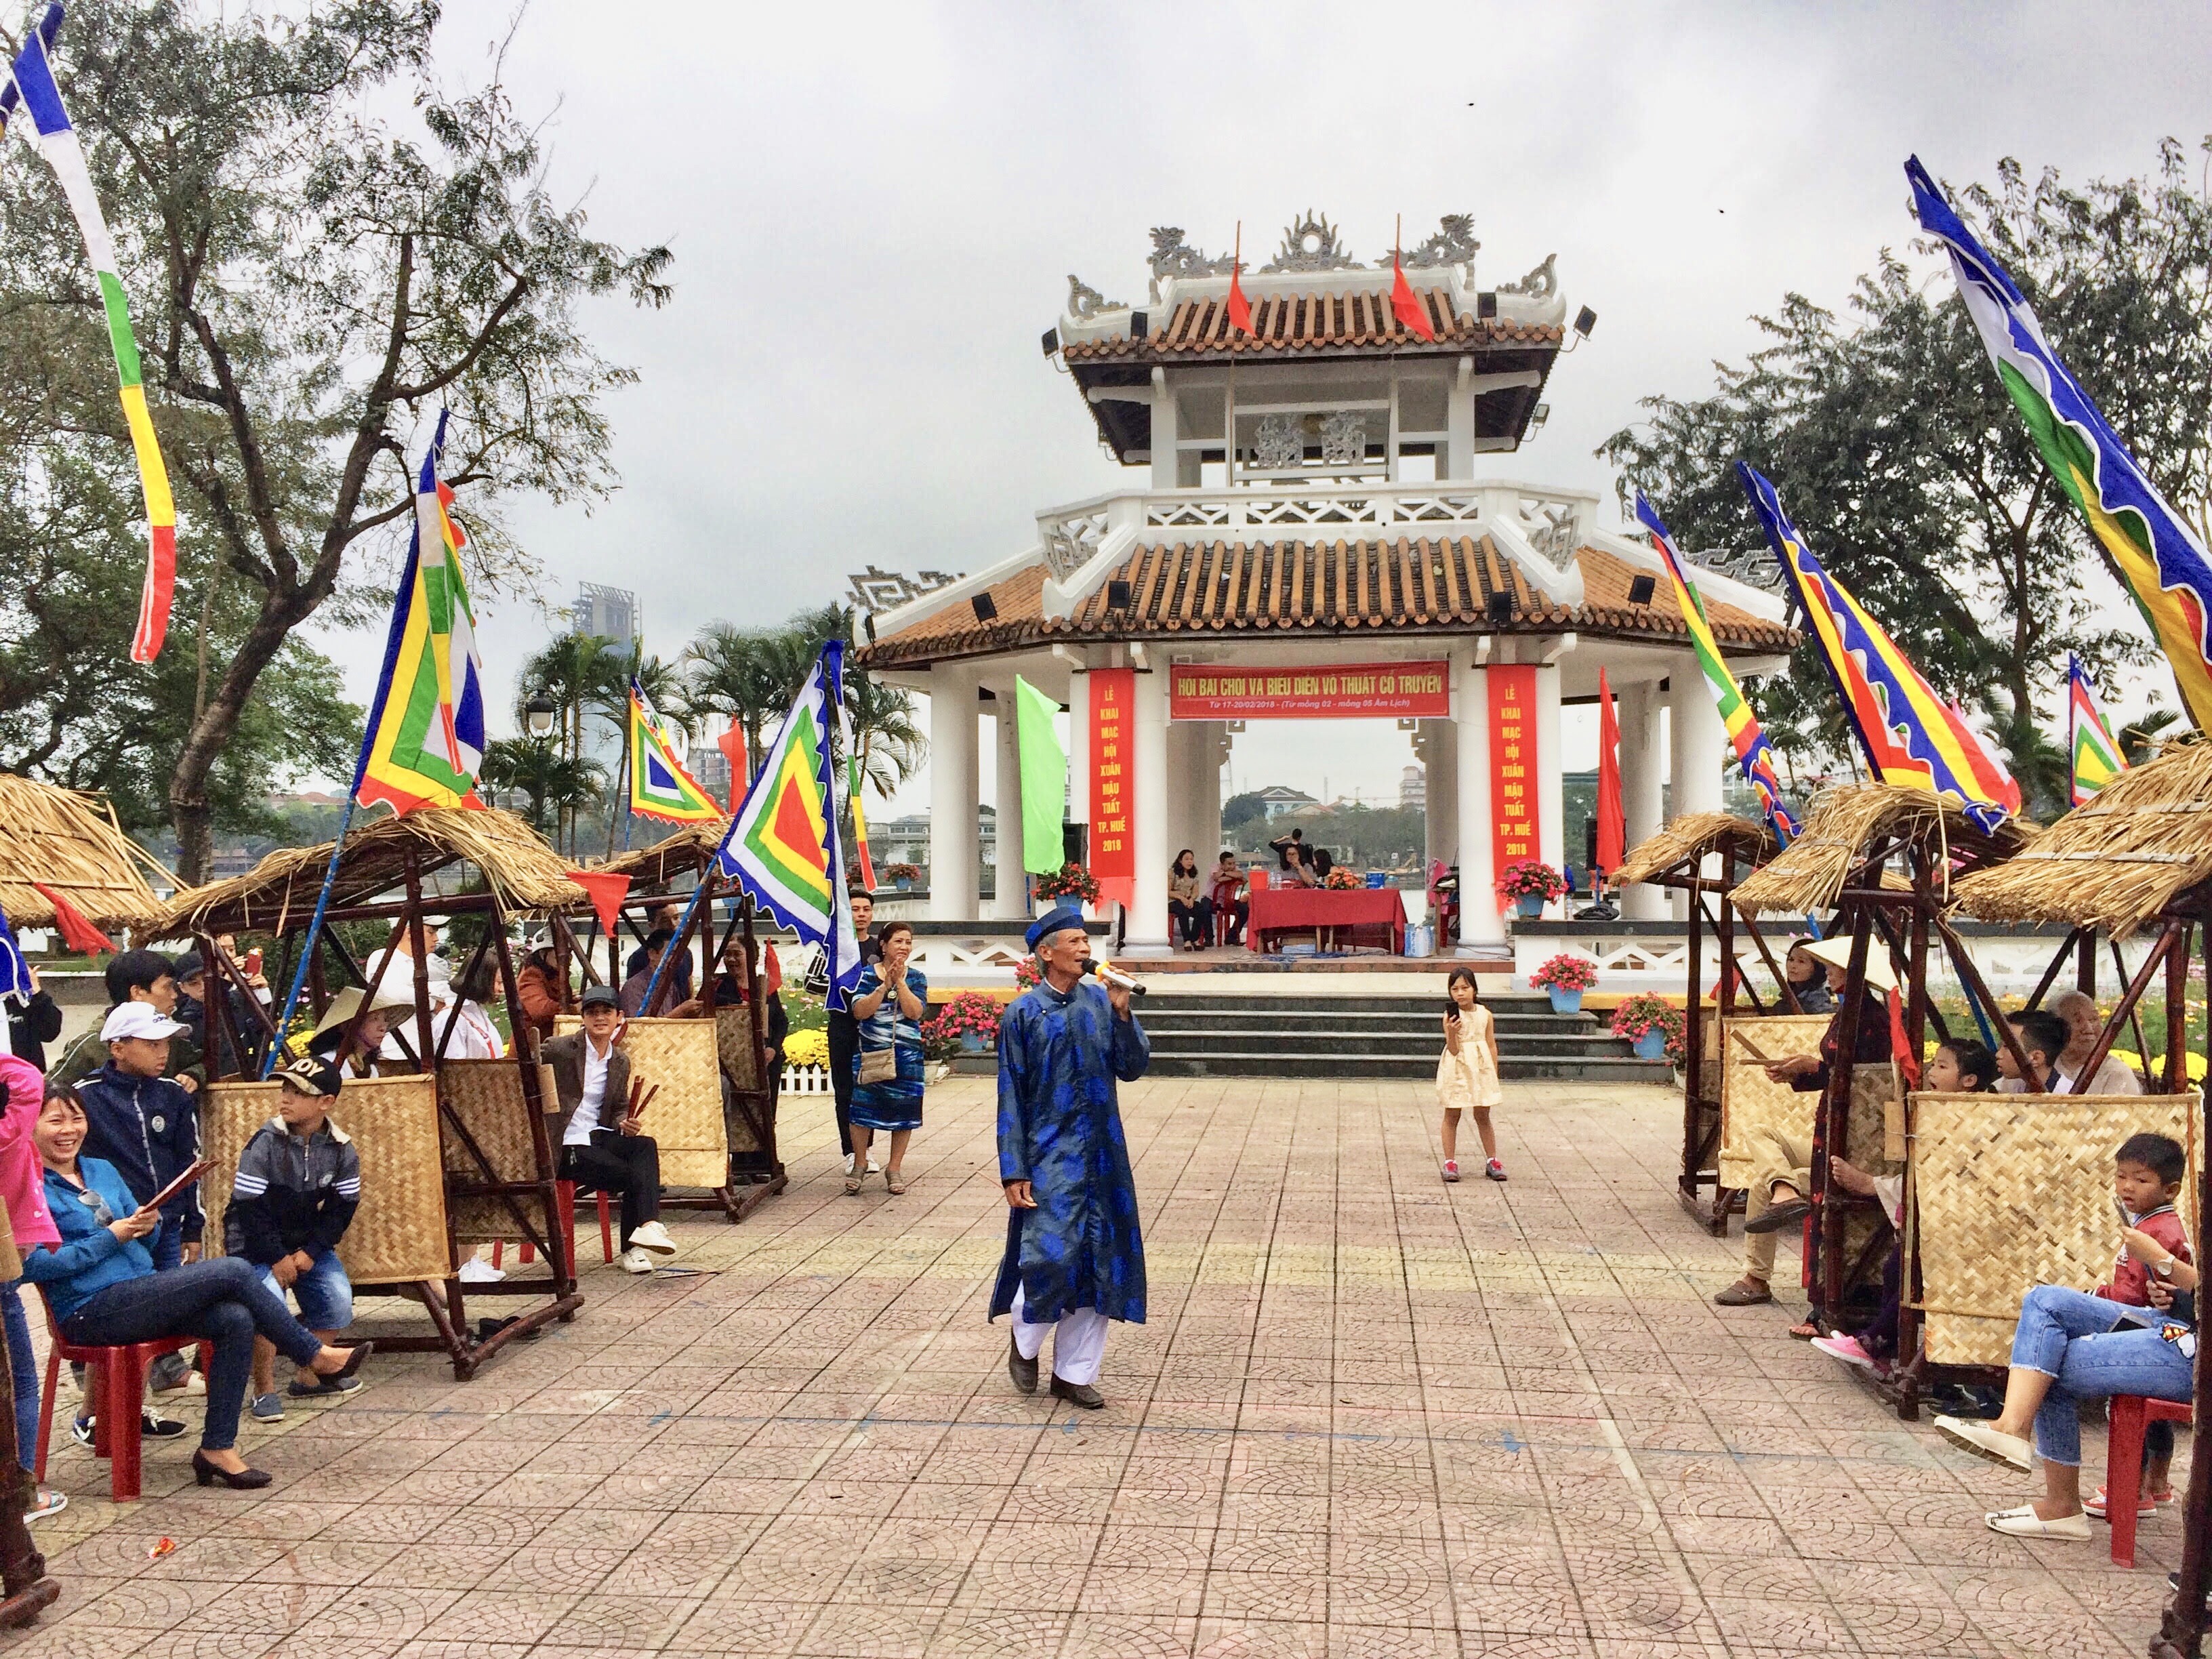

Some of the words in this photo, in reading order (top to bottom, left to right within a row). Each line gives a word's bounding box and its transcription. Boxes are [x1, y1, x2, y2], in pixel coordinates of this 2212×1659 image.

[1100, 708, 1119, 720] KHAI
[1501, 708, 1521, 720] KHAI
[1098, 821, 1109, 834] TP.
[1500, 823, 1513, 836] TP.
[1103, 839, 1122, 852] 2018
[1507, 843, 1527, 855] 2018
